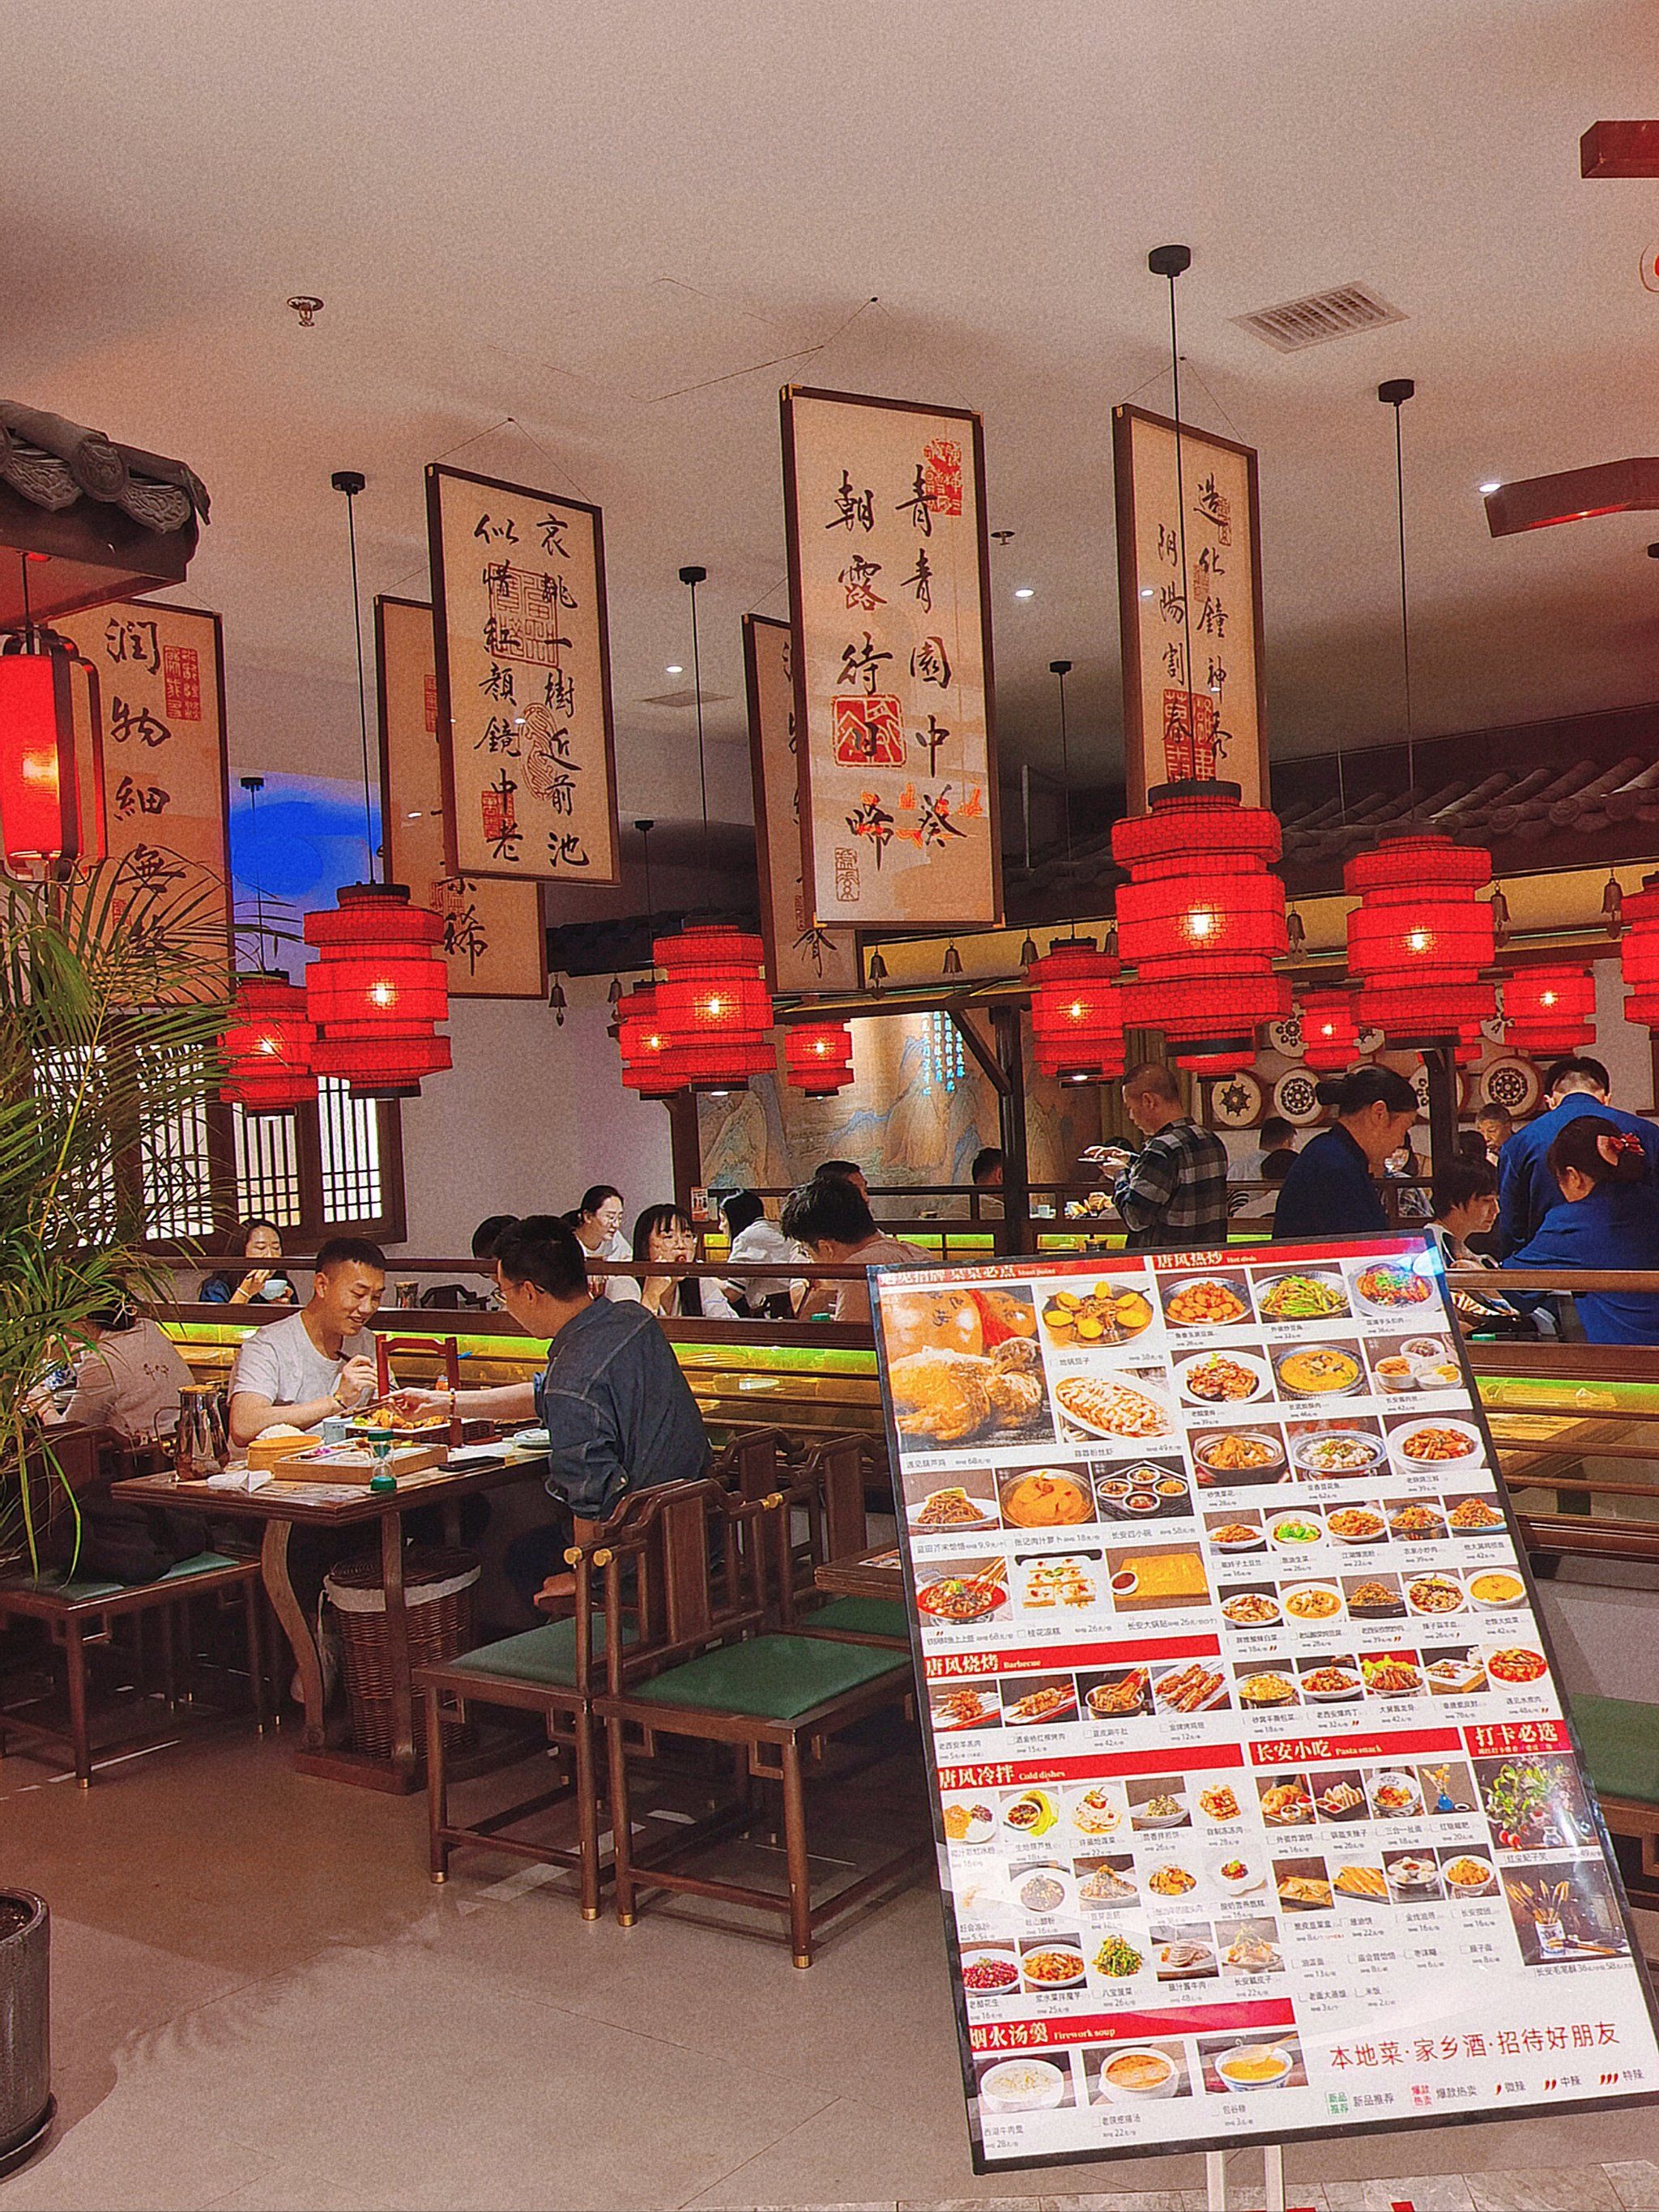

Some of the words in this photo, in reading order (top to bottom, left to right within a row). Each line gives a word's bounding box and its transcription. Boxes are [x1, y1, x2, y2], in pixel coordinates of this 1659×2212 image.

[924, 1652, 1000, 1677] 唐风烧烤
[1003, 1659, 1041, 1669] Barbecue
[1473, 1720, 1559, 1747] 打卡必选
[1255, 1738, 1332, 1763] 长安小吃
[938, 1763, 1015, 1788] 唐风冷拌
[1018, 1771, 1038, 1782] Cold
[970, 2020, 1049, 2050] 烟火汤羹
[1053, 2027, 1093, 2041] Firework
[1093, 2026, 1116, 2039] soup
[1327, 2018, 1621, 2072] 本地菜·家乡酒·招待好朋友
[1559, 2073, 1581, 2087] 中辣
[1621, 2068, 1645, 2081] 特辣
[1410, 2084, 1431, 2095] 爆款
[1435, 2084, 1478, 2100] 爆款热卖
[1503, 2079, 1526, 2093] 微辣
[1327, 2092, 1348, 2103] 新品
[1352, 2092, 1396, 2108] 新品推荐
[1412, 2094, 1433, 2106] 热卖
[1328, 2103, 1350, 2115] 推荐
